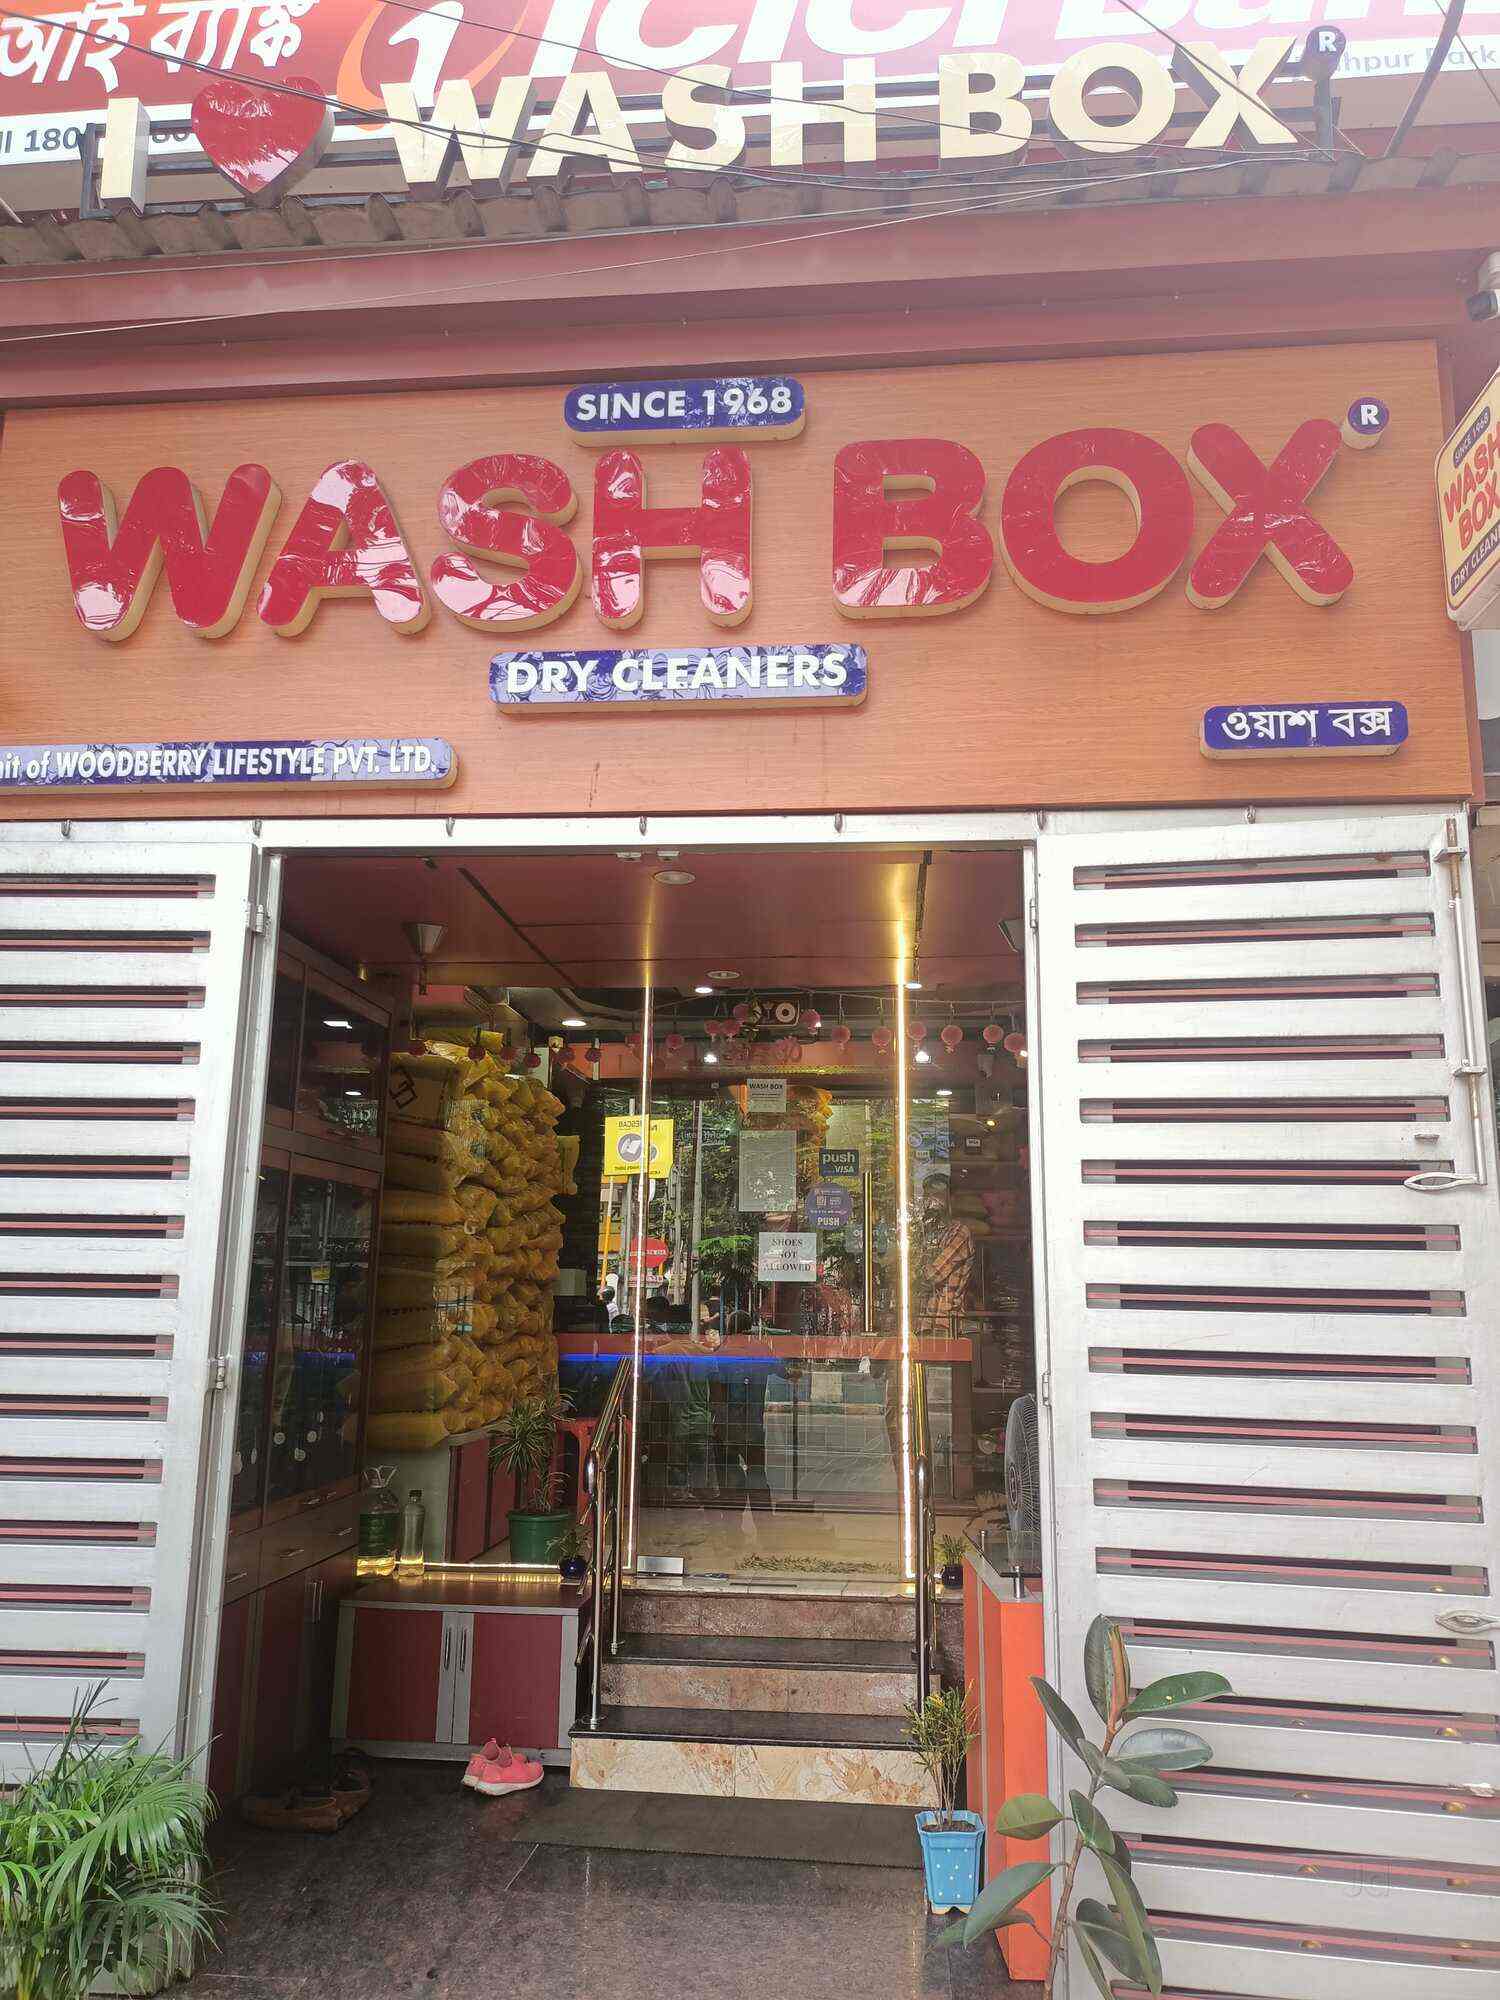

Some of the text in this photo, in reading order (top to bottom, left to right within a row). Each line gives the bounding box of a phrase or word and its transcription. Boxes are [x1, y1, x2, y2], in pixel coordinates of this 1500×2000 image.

[1338, 50, 1415, 73] hpur
[381, 58, 877, 184] WASH
[939, 38, 1298, 159] BOX
[576, 387, 793, 421] SINCE 1968
[1454, 432, 1472, 466] SINCE
[1444, 420, 1500, 523] WASH
[58, 418, 1354, 634] WASH BOX
[1458, 471, 1500, 551] BOX
[1454, 563, 1470, 589] DRY
[506, 653, 848, 694] DRY CLEANERS
[1222, 706, 1393, 742] ওয়াশ বক্স
[26, 751, 50, 777] of
[57, 748, 207, 777] WOODBERRY
[214, 746, 325, 776] LIFESTYLE
[332, 746, 381, 774] PVT.
[390, 744, 437, 774] LTD.
[822, 1151, 856, 1165] push
[834, 1165, 855, 1173] VISA
[817, 1216, 840, 1226] PUSH
[771, 1238, 803, 1247] SHOES
